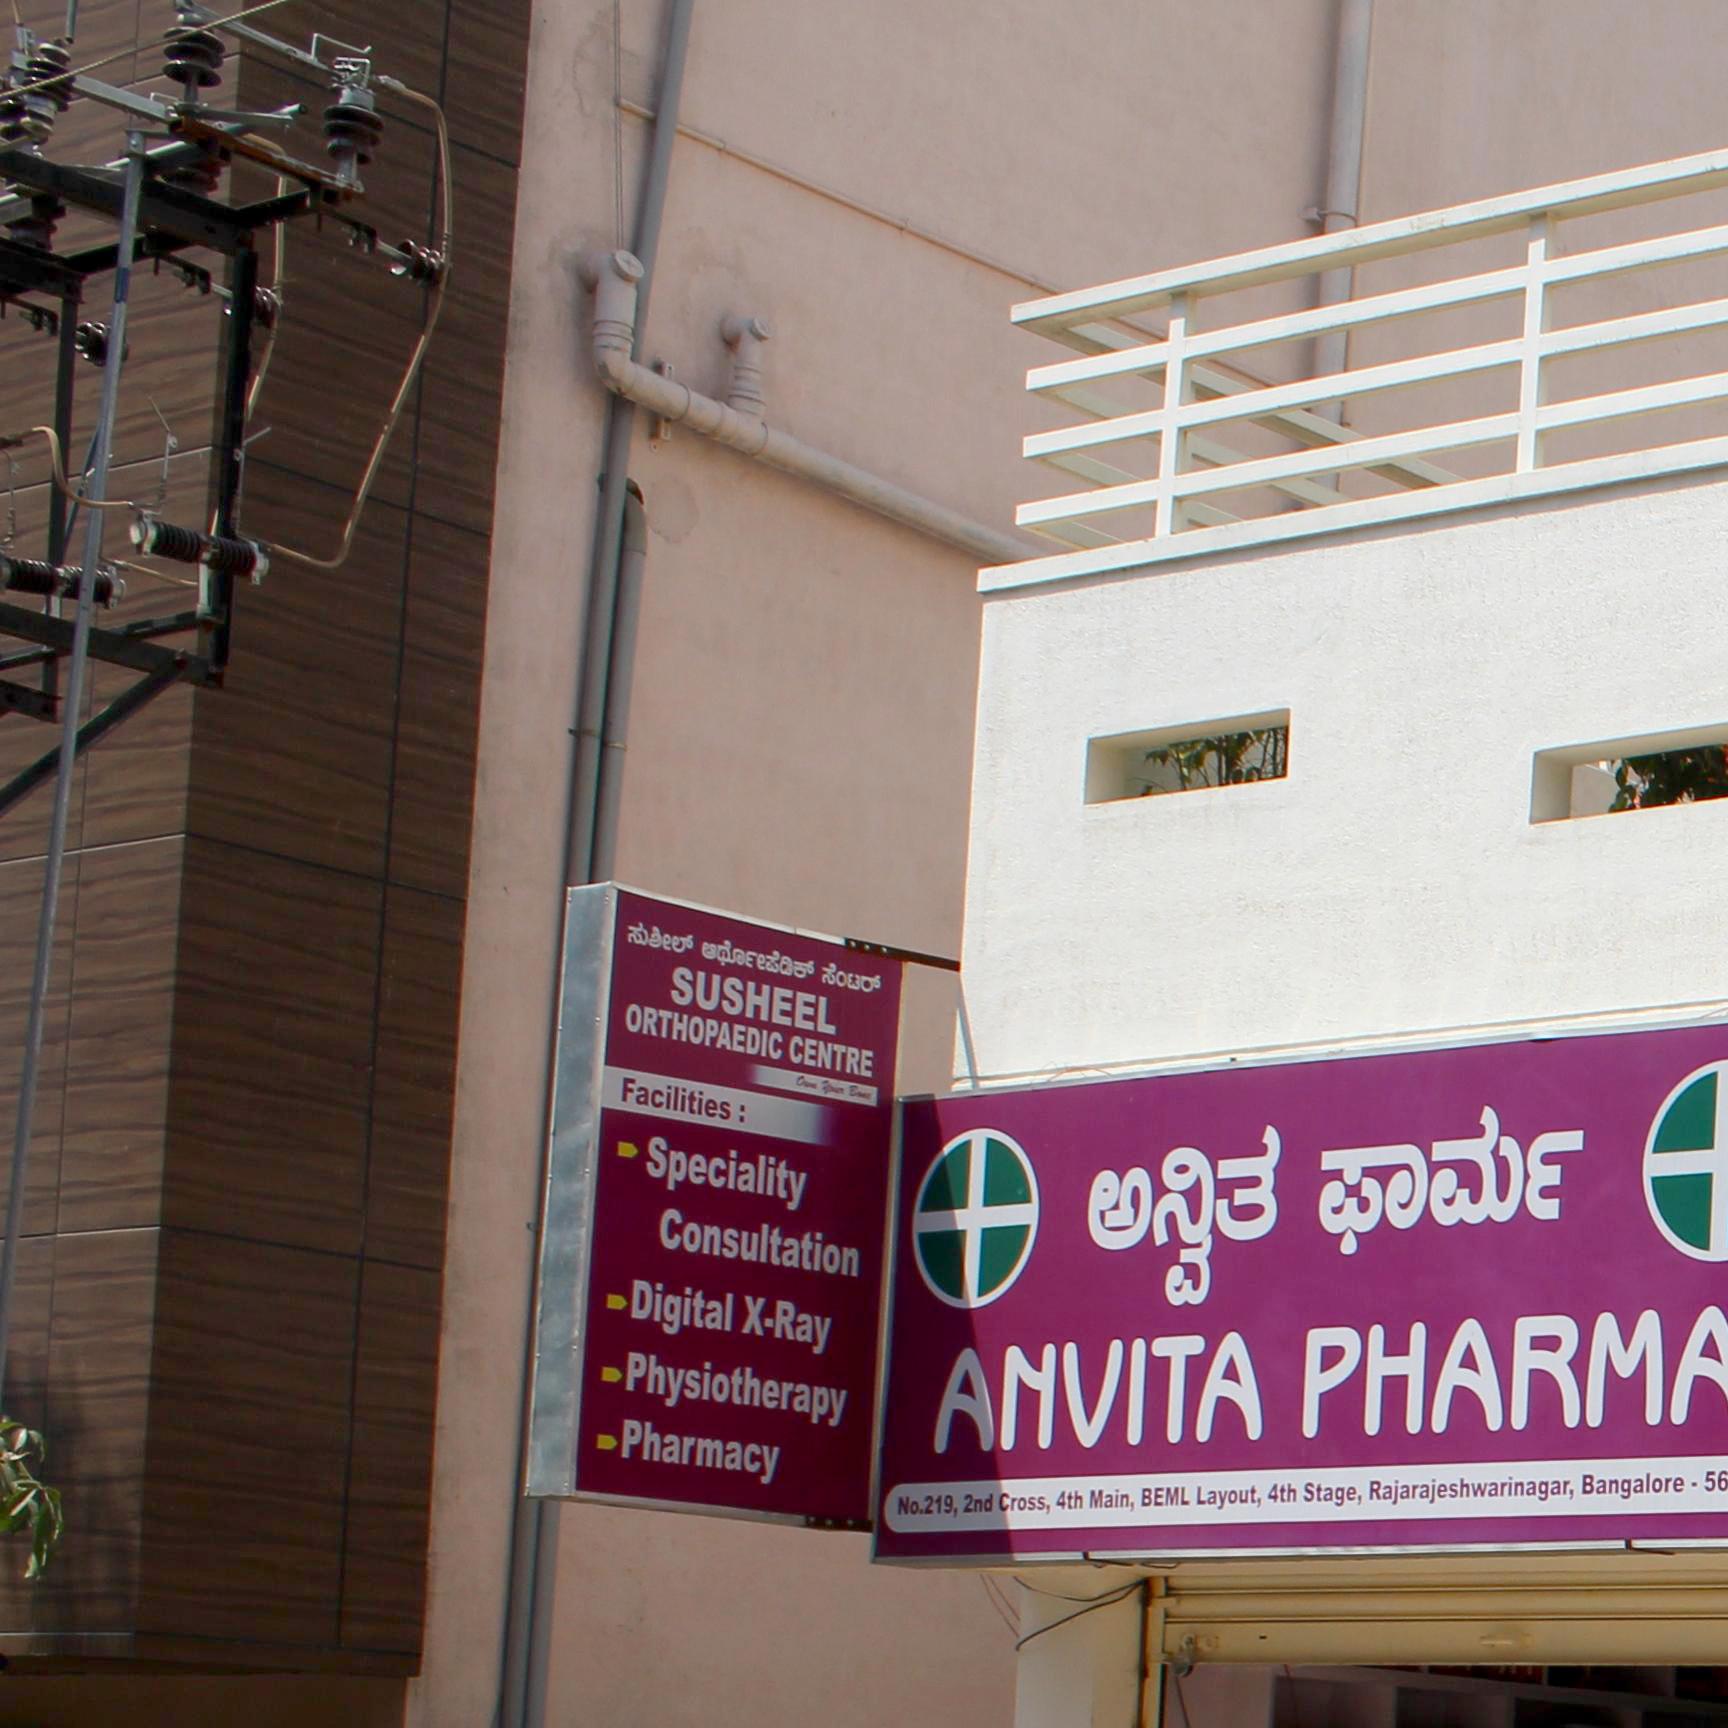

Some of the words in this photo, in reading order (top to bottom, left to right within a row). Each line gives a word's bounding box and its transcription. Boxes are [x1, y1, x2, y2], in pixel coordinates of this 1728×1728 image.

[670, 966, 837, 1035] SUSHEEL
[625, 1004, 783, 1060] ORTHOPAEDIC
[789, 1035, 874, 1078] CENTRE
[622, 1077, 731, 1121] Facilities
[646, 1136, 807, 1210] Speciality
[659, 1208, 860, 1278] Consultation
[1088, 1124, 1281, 1306] ಅನ್ವಿತ
[630, 1279, 734, 1335] Digital
[742, 1295, 832, 1354] X-Ray
[625, 1351, 848, 1428] Physiotherapy
[933, 1330, 1263, 1454] ANVITA
[620, 1418, 780, 1485] Pharmacy
[897, 1494, 958, 1519] No.219,
[963, 1493, 994, 1514] 2nd
[999, 1492, 1051, 1515] Cross,
[1055, 1489, 1084, 1511] 4th
[1089, 1488, 1135, 1513] Main,
[1140, 1485, 1190, 1507] BEML
[1196, 1484, 1262, 1511] Layout,
[1267, 1481, 1297, 1503] 4th
[1303, 1480, 1363, 1506] Stage,
[1368, 1476, 1575, 1507] Rajarajeshwarinagar,
[1581, 1472, 1685, 1499] Bangalore
